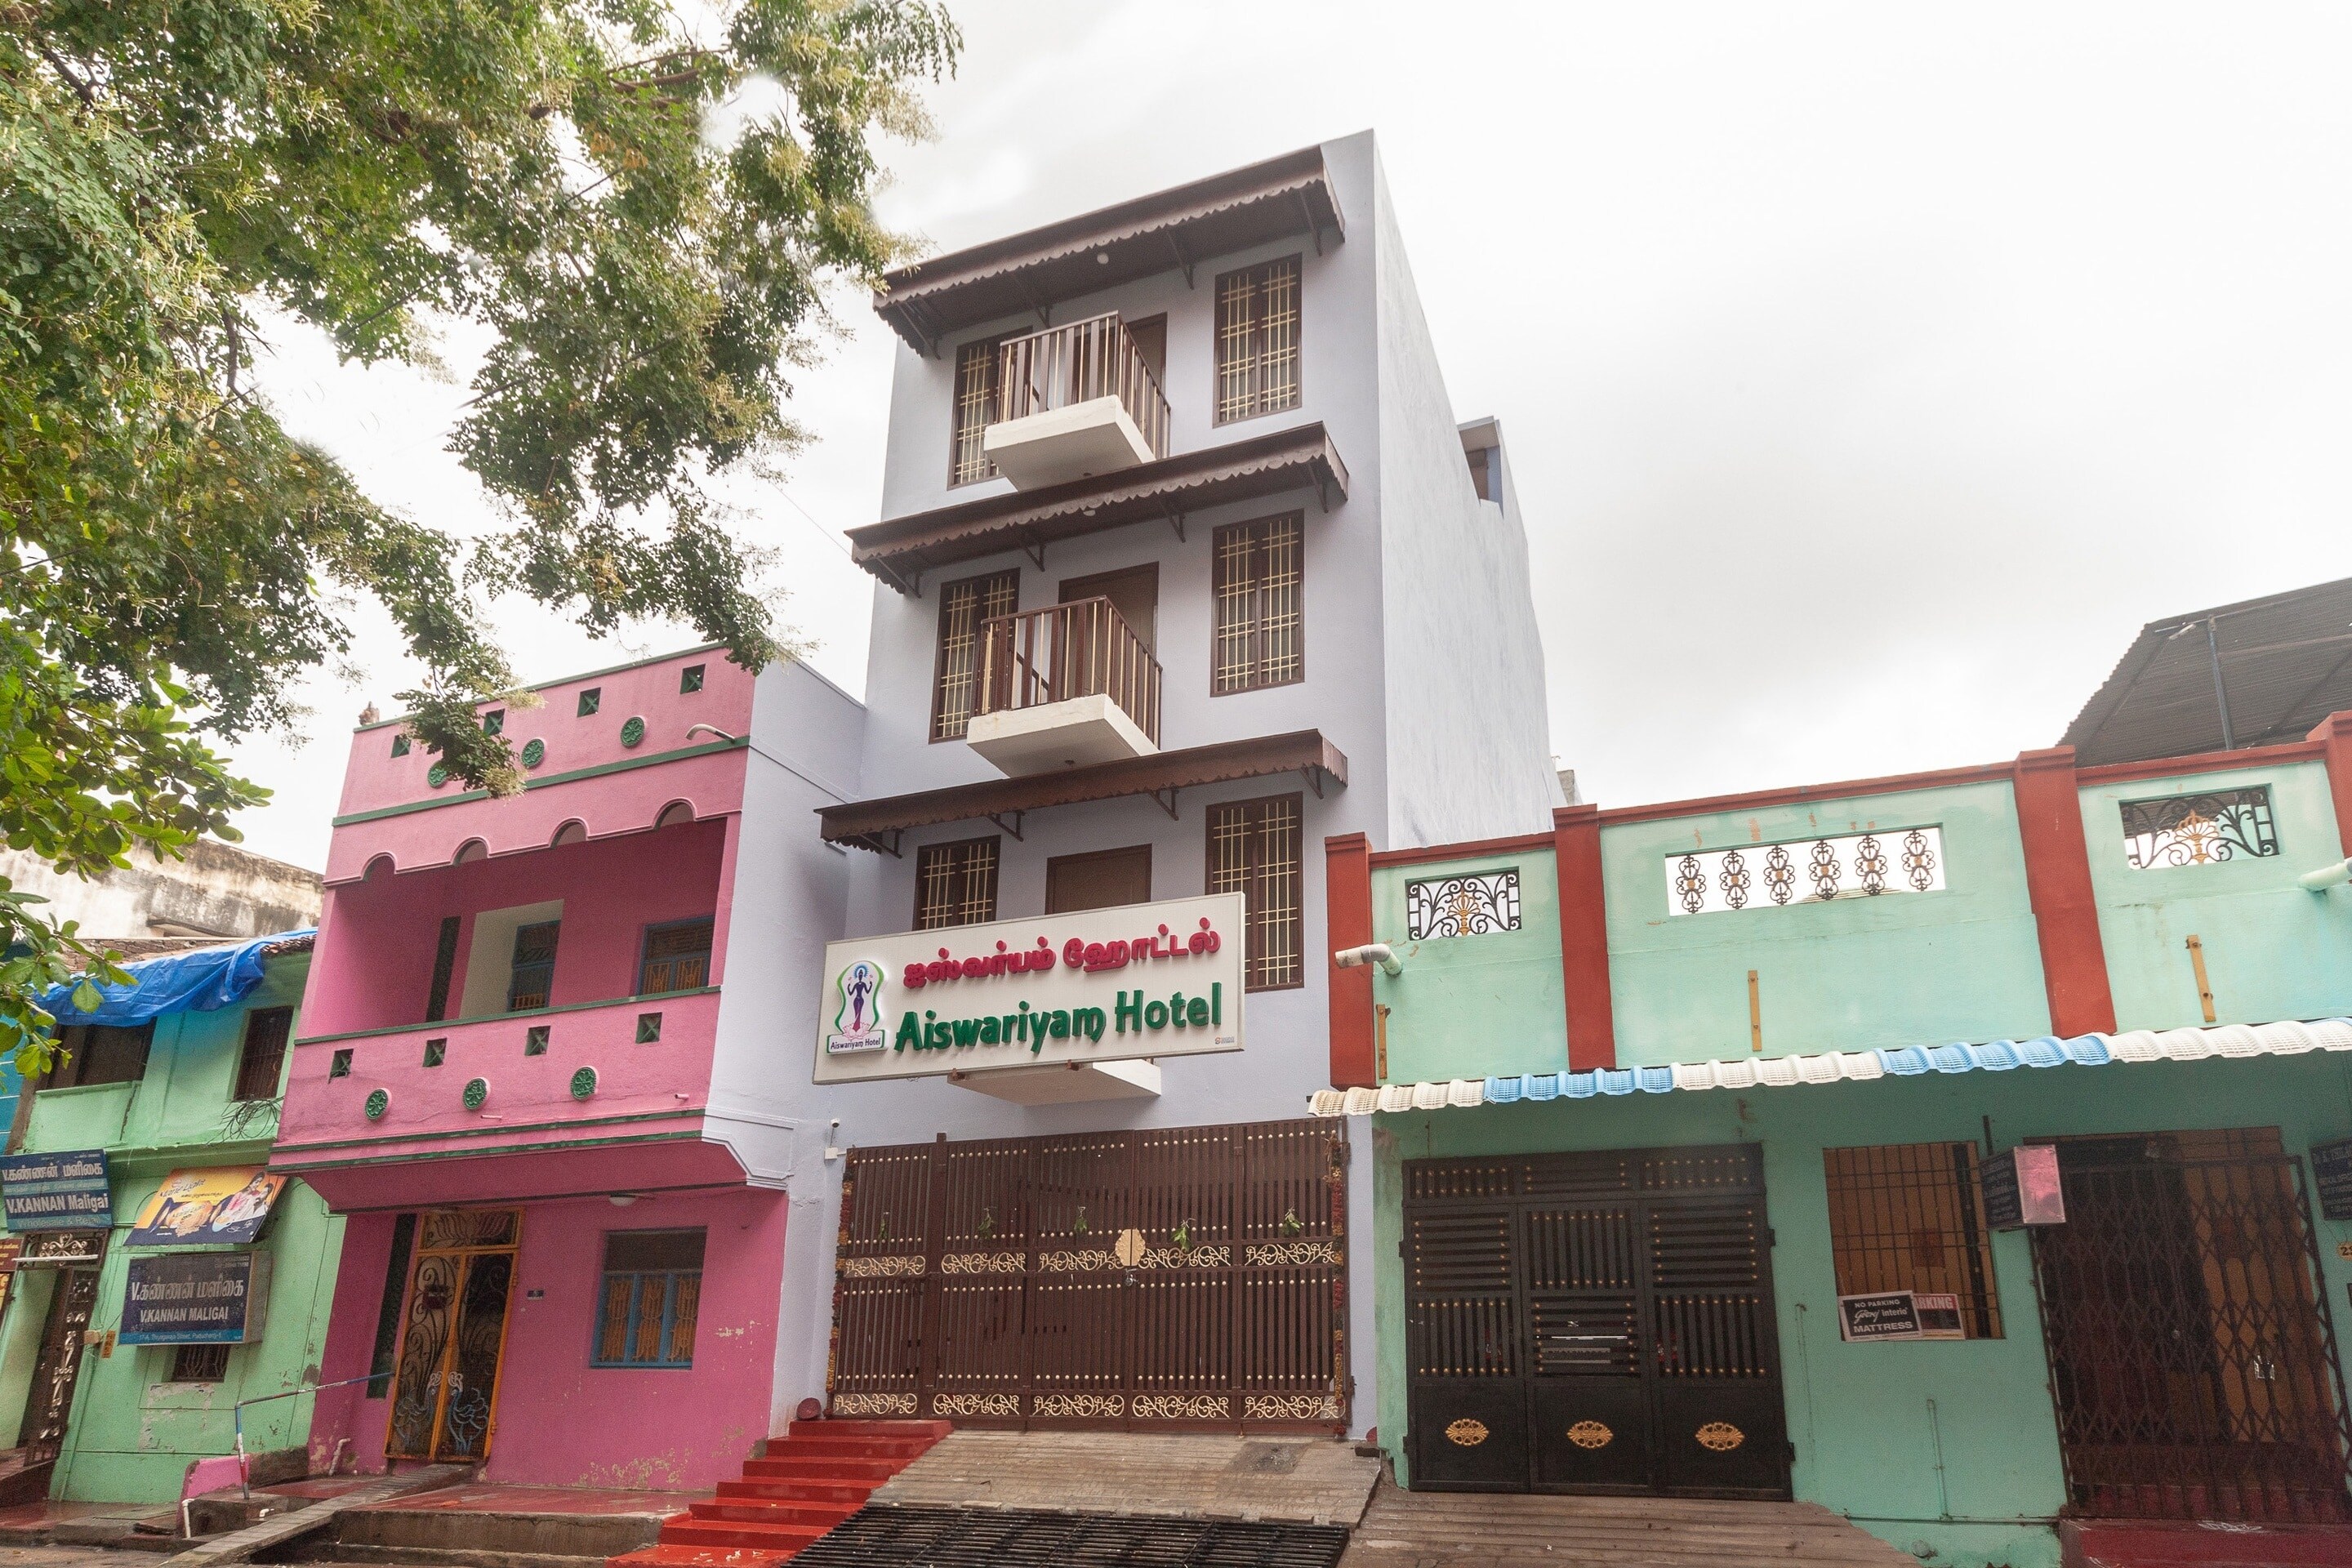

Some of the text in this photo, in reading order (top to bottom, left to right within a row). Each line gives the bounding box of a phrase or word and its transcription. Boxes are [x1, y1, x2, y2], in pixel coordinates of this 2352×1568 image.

[903, 917, 1221, 988] ஐஸ்வர்யம் ஹோட்டல்
[894, 982, 1222, 1054] Aiswariyam Hotel
[831, 1037, 881, 1049] Aiswariyam Hotel
[6, 1193, 109, 1214] V.KANNAN Maligai
[1868, 1298, 1900, 1307] PARKING
[1913, 1296, 1953, 1309] ARKING
[140, 1307, 229, 1323] V.KANNAN MALIGAI
[1881, 1307, 1908, 1316] interio
[1854, 1321, 1913, 1333] MATTRESS
